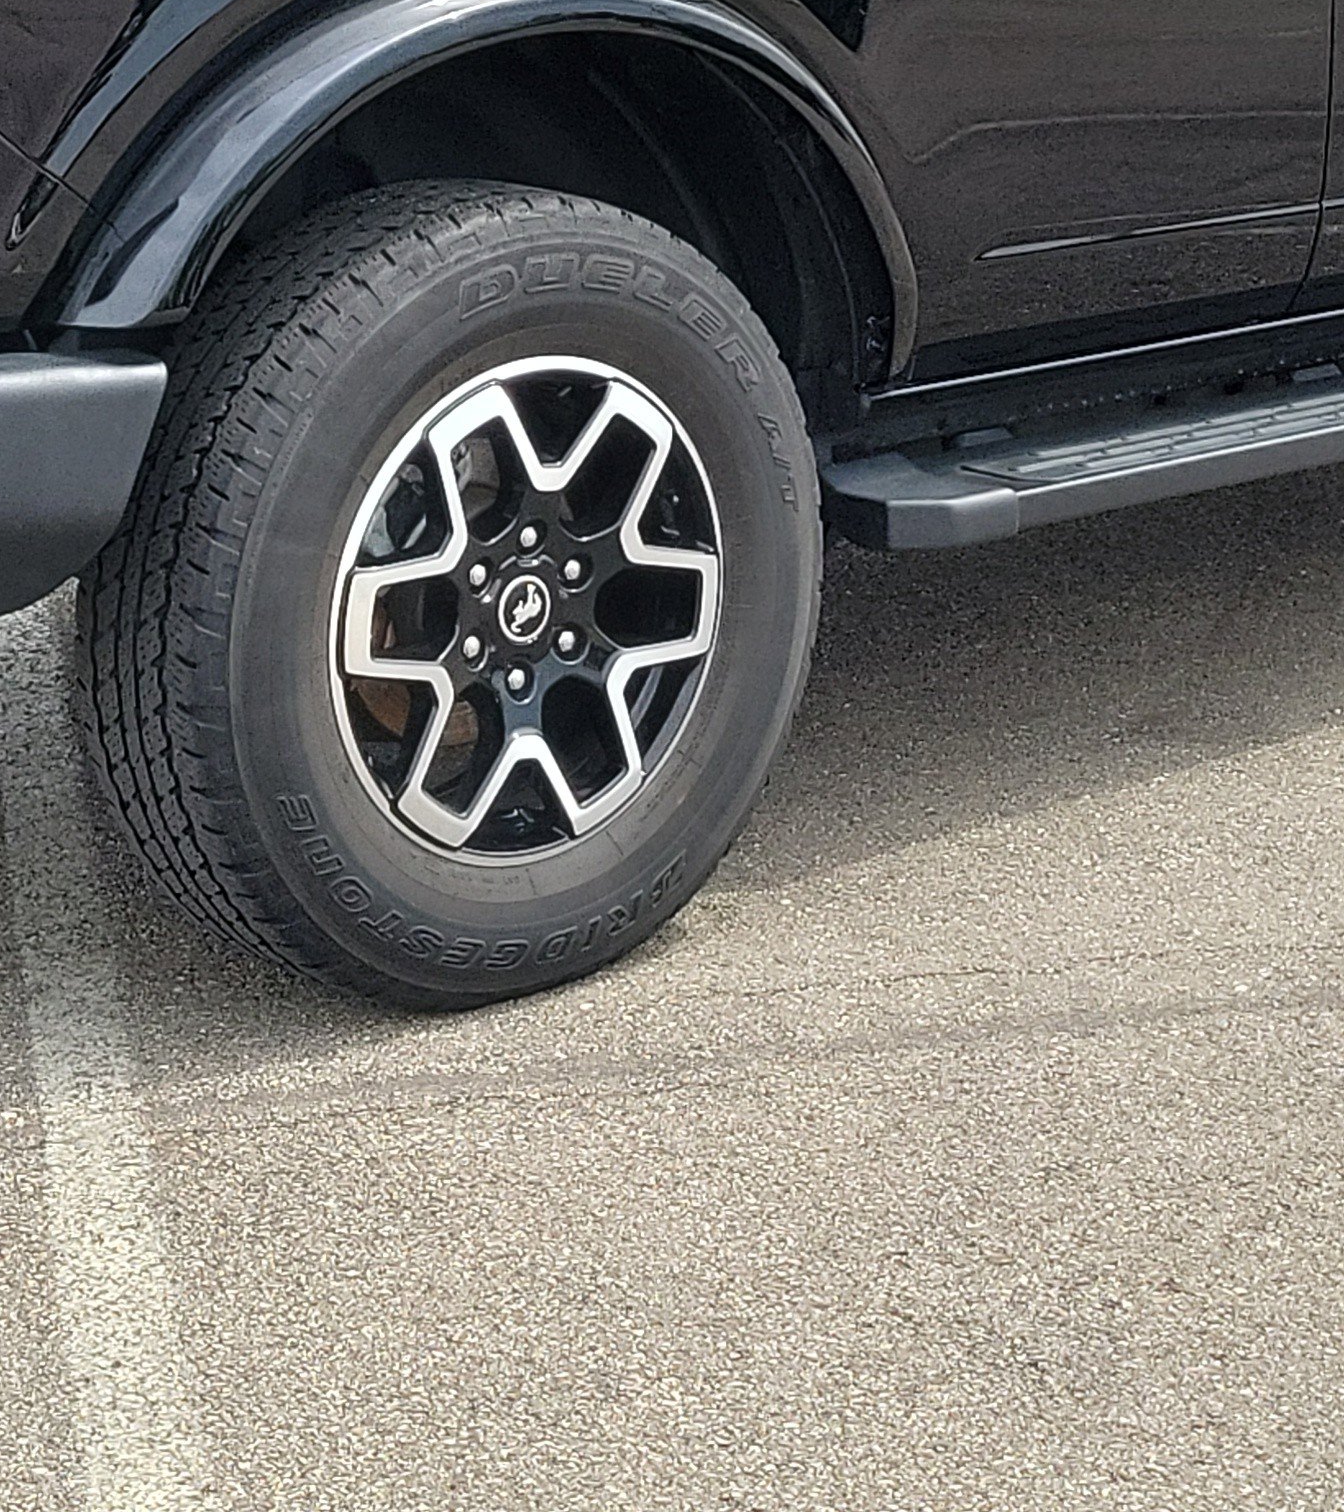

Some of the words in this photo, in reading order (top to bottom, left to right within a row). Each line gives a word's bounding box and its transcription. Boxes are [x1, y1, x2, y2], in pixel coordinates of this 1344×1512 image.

[458, 250, 760, 394] DUELER
[757, 412, 800, 514] A/T
[276, 793, 689, 972] BRIDGESTONE
